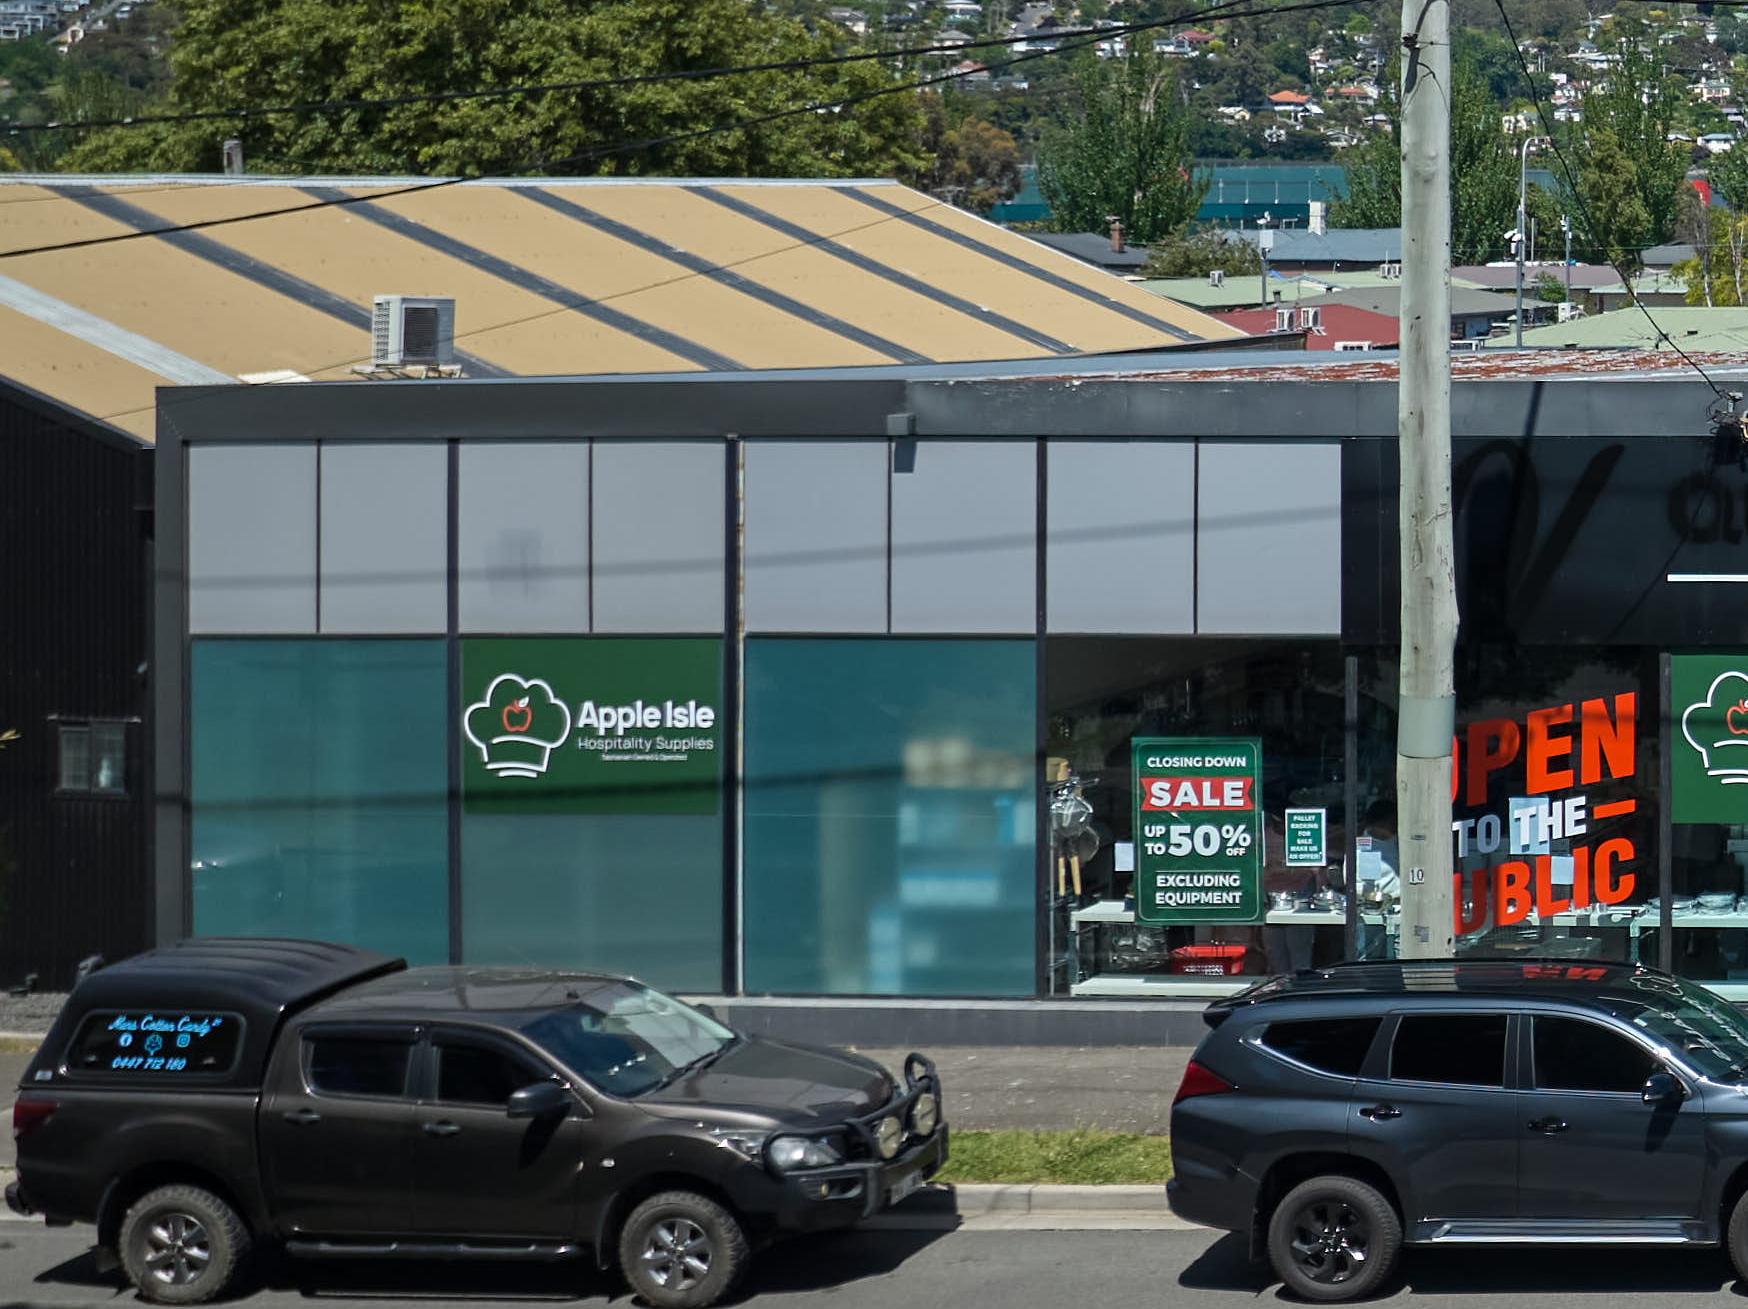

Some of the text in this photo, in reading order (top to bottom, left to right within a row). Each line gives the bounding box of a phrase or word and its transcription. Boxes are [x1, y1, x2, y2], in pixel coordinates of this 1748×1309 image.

[577, 700, 715, 736] Apple Isle
[578, 737, 714, 752] Hospitality Supplies
[1452, 692, 1635, 807] PEN
[1147, 757, 1247, 768] CLOSING DOWN
[1150, 781, 1245, 807] SALE
[1144, 826, 1166, 838] UP
[1452, 795, 1587, 858] TO THE
[1144, 825, 1251, 856] TO 50%
[1226, 848, 1245, 856] OFF
[1156, 875, 1240, 887] EXCLUDING
[1411, 868, 1424, 881] 10
[1453, 838, 1635, 935] UBLIC
[1155, 892, 1242, 906] EQUIPMENT
